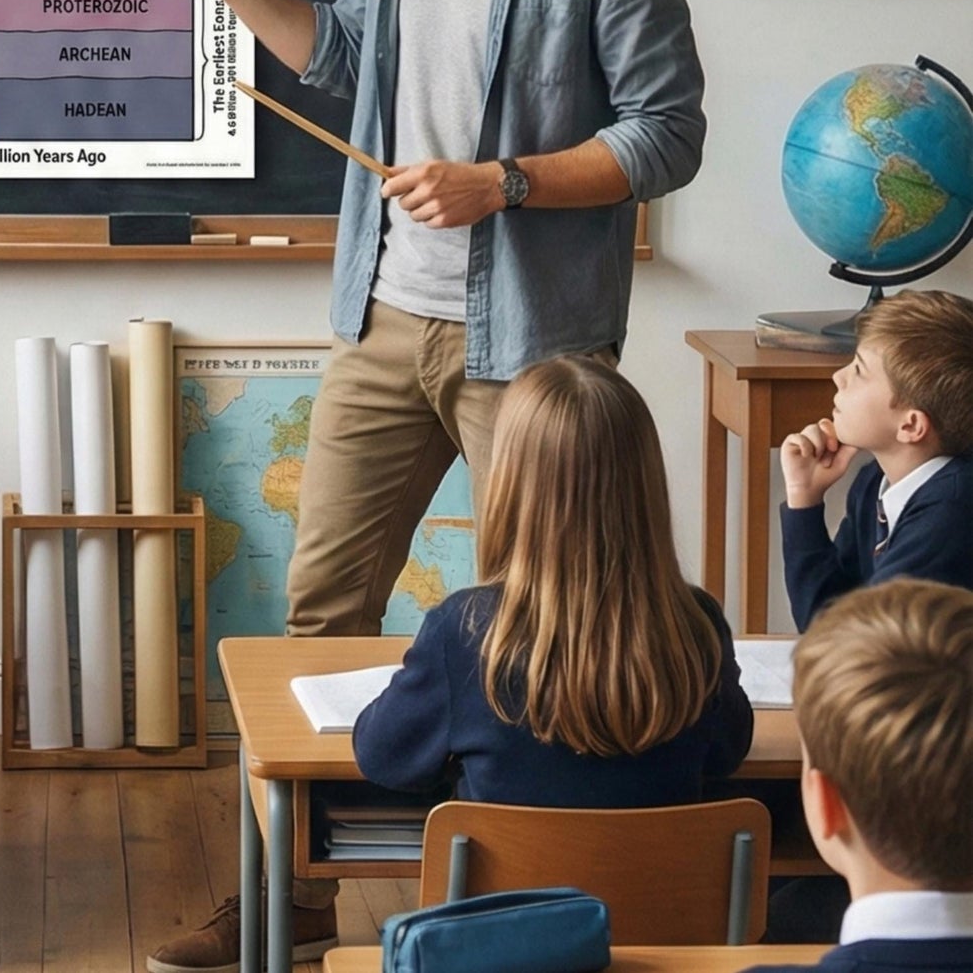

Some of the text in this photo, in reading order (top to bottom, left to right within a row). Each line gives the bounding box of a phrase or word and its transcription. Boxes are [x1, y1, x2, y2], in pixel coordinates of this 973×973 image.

[43, 0, 148, 13] PROTEROZOIC
[59, 47, 132, 61] ARCHEAN
[213, 90, 224, 114] The
[64, 103, 127, 117] HADEAN
[33, 149, 74, 164] Years
[77, 149, 107, 167] Ago
